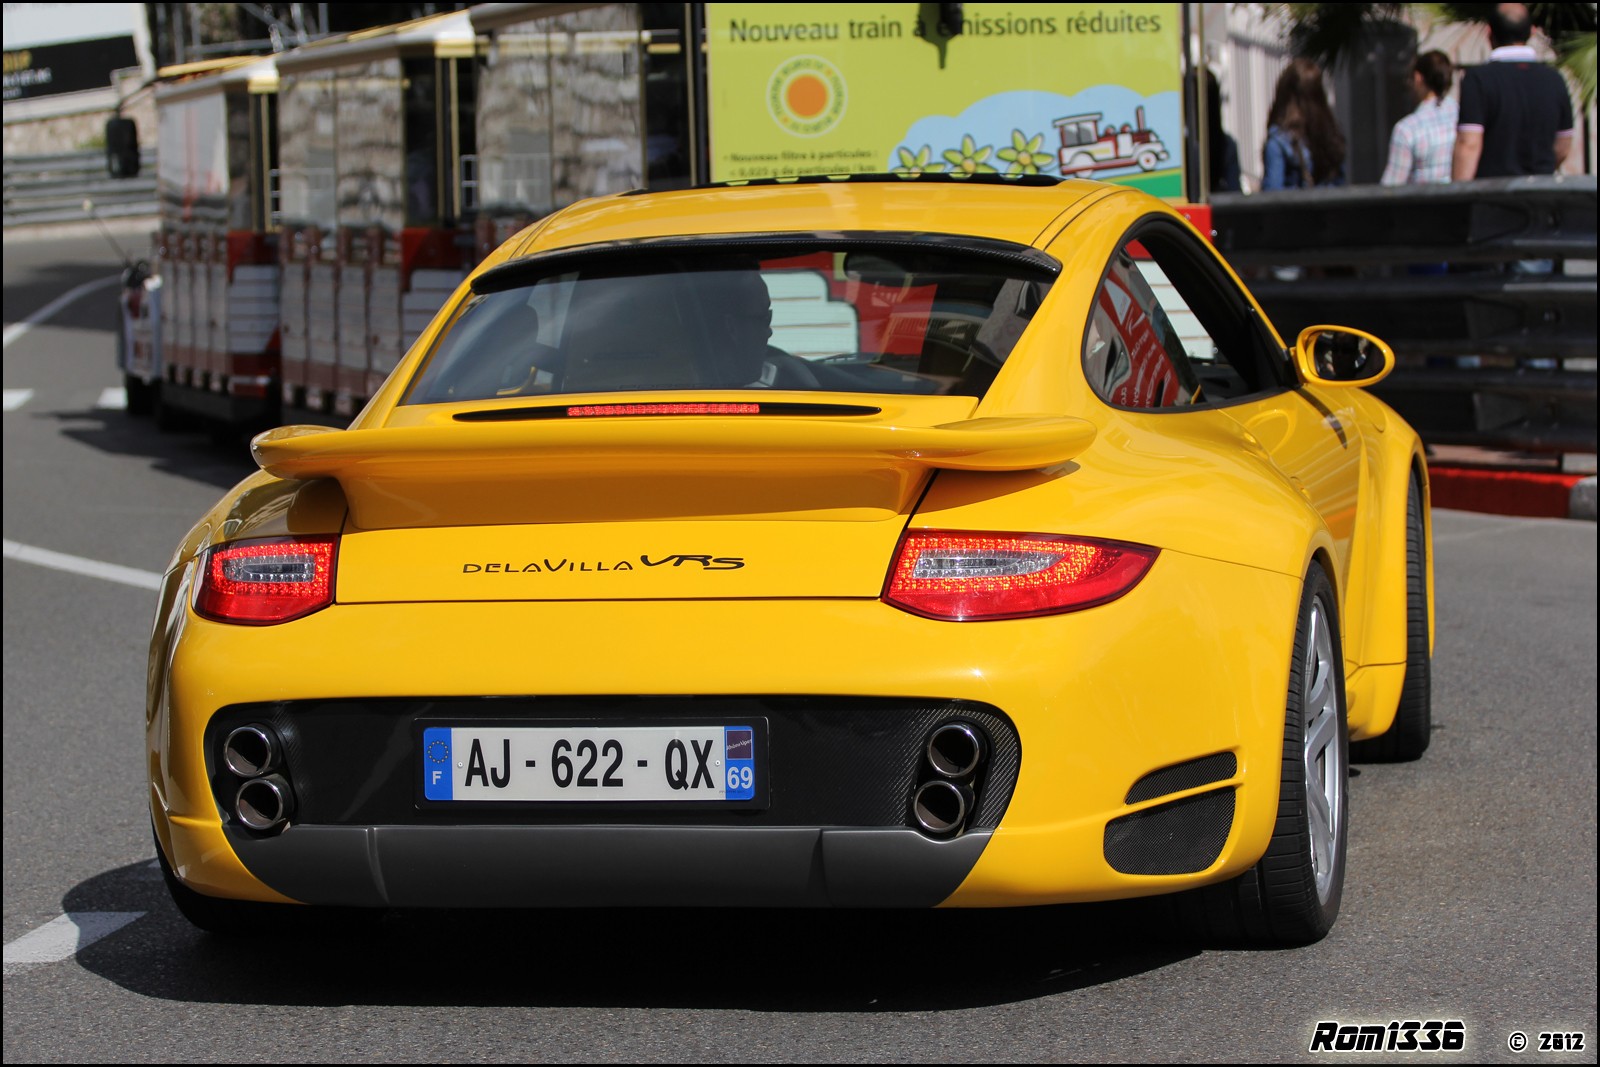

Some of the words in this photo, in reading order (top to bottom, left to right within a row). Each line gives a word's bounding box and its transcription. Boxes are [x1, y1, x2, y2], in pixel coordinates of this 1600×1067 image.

[729, 18, 839, 42] Nouveau
[849, 15, 902, 39] train
[1066, 9, 1162, 34] réduites
[462, 558, 634, 574] DELAVILLA
[640, 554, 746, 570] VRS
[431, 770, 443, 785] F
[464, 738, 511, 789] AJ
[551, 738, 624, 789] 622
[664, 738, 716, 791] QX
[727, 766, 753, 790] 69
